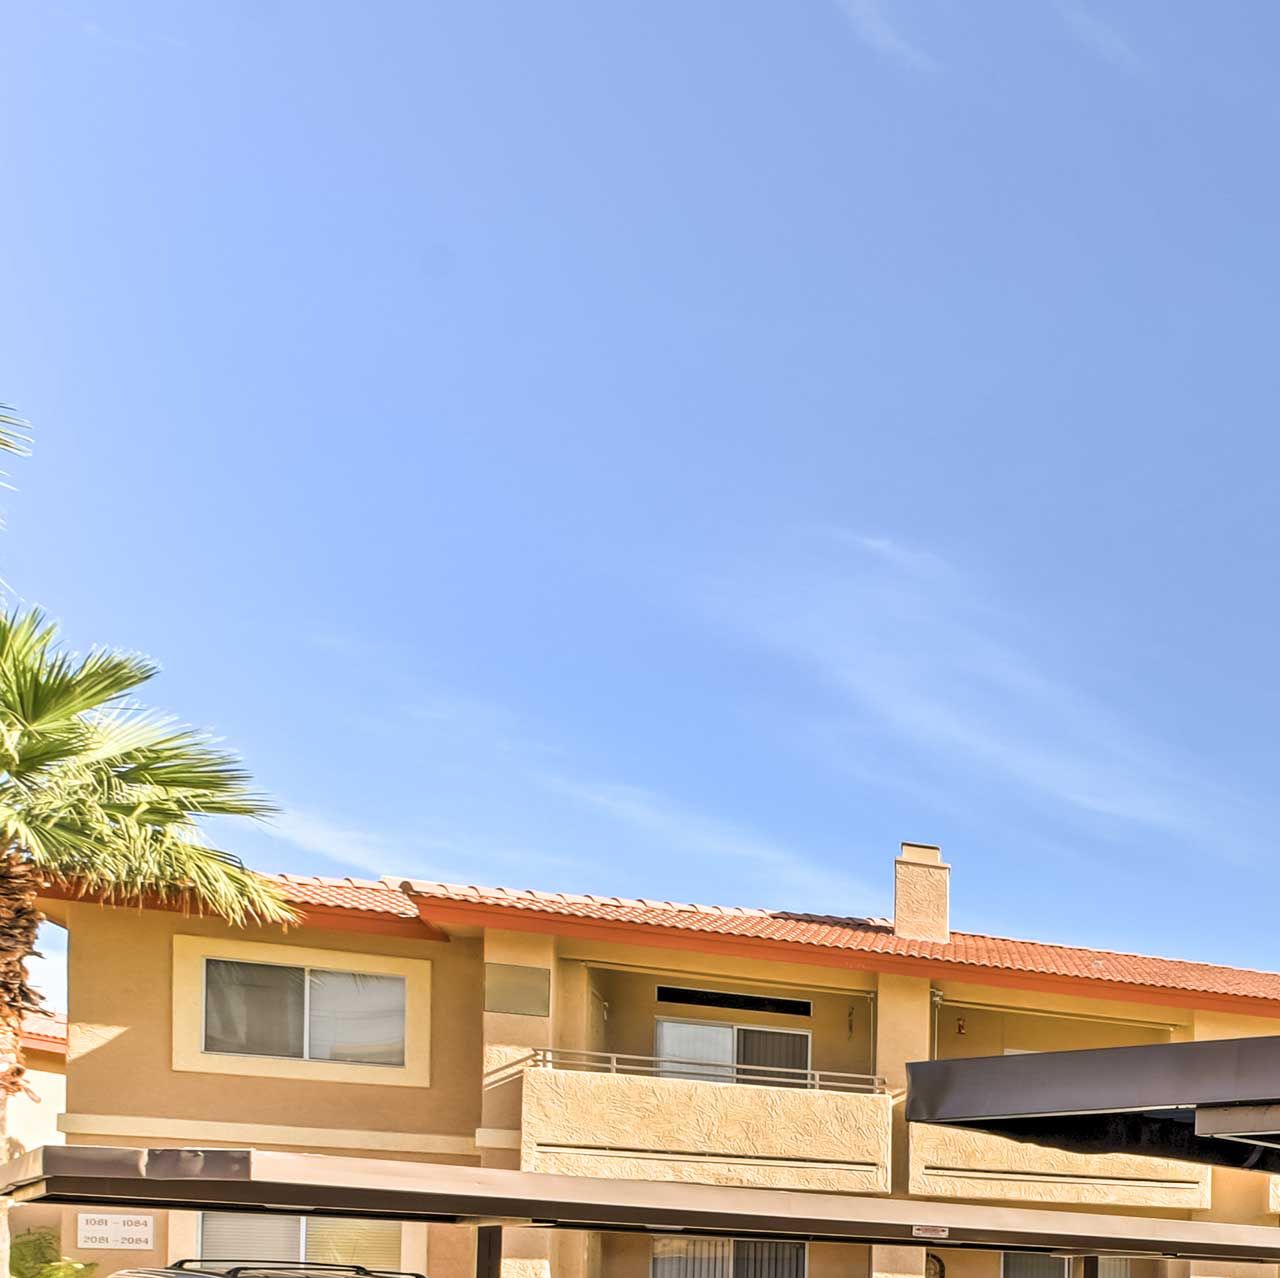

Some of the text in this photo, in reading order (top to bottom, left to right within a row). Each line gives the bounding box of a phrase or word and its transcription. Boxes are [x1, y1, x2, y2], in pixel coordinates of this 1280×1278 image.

[85, 1218, 108, 1226] 1081
[122, 1219, 148, 1228] 1084
[120, 1237, 149, 1245] 2084
